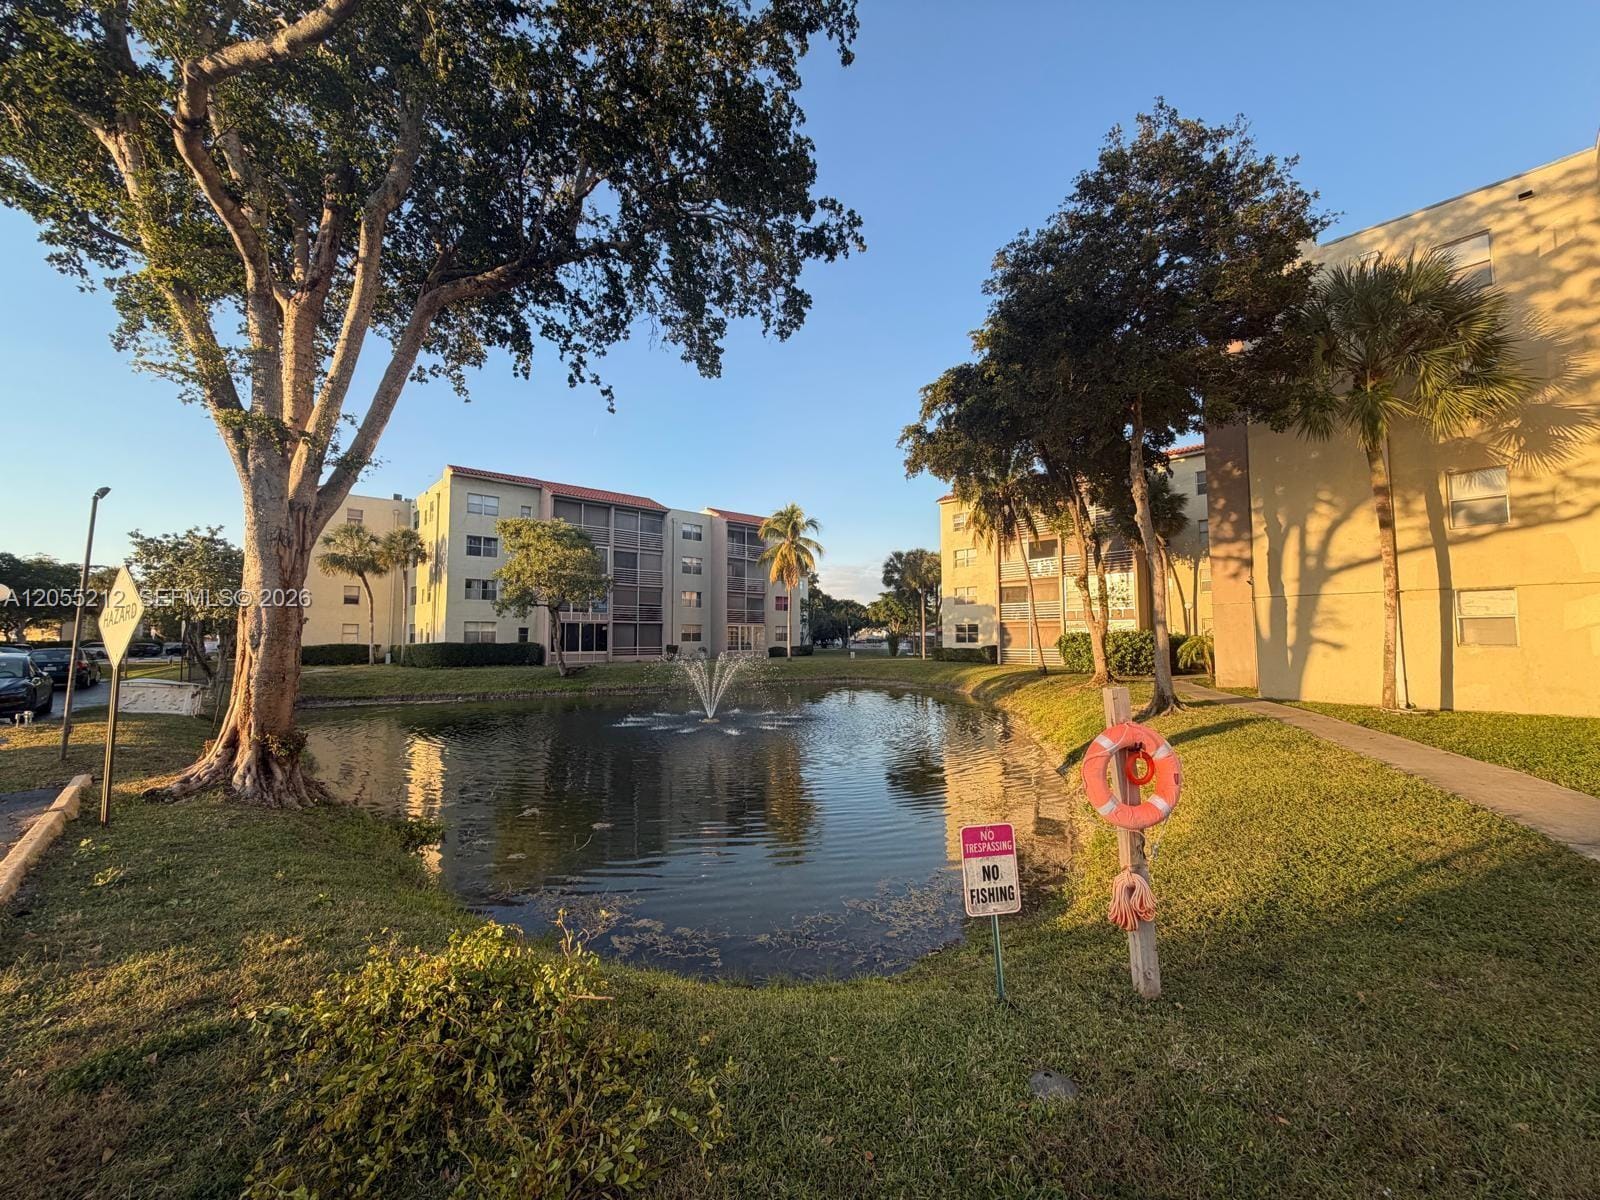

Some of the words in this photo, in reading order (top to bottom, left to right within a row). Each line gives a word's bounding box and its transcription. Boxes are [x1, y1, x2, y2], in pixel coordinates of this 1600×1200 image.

[103, 602, 137, 628] HAZARD
[980, 830, 995, 841] NO
[964, 840, 1013, 854] TRESPASSING
[981, 864, 1000, 882] NO
[969, 885, 1015, 905] FISHING
